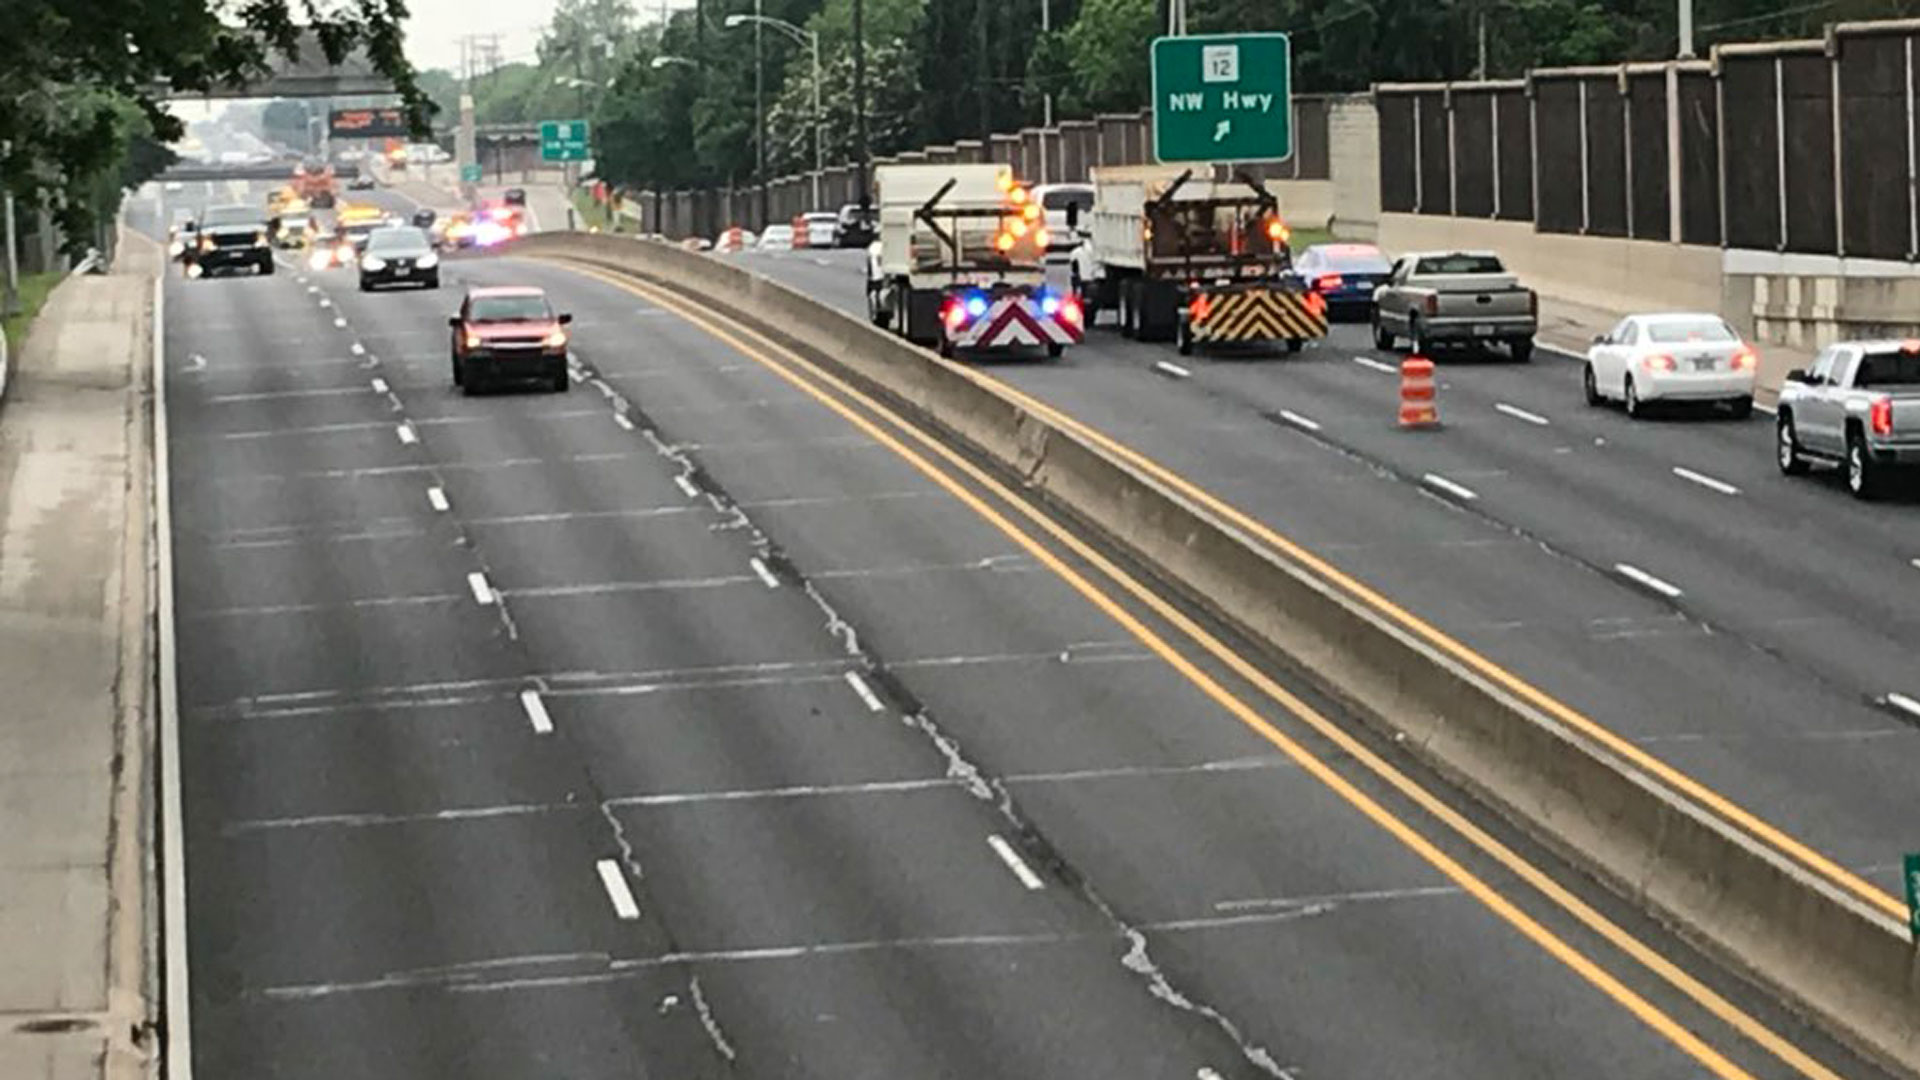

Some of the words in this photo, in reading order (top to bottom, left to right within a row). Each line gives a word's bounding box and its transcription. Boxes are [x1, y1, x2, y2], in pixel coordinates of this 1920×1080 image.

[1212, 59, 1231, 76] 12
[1169, 92, 1203, 111] NW
[1223, 91, 1272, 113] Hwy
